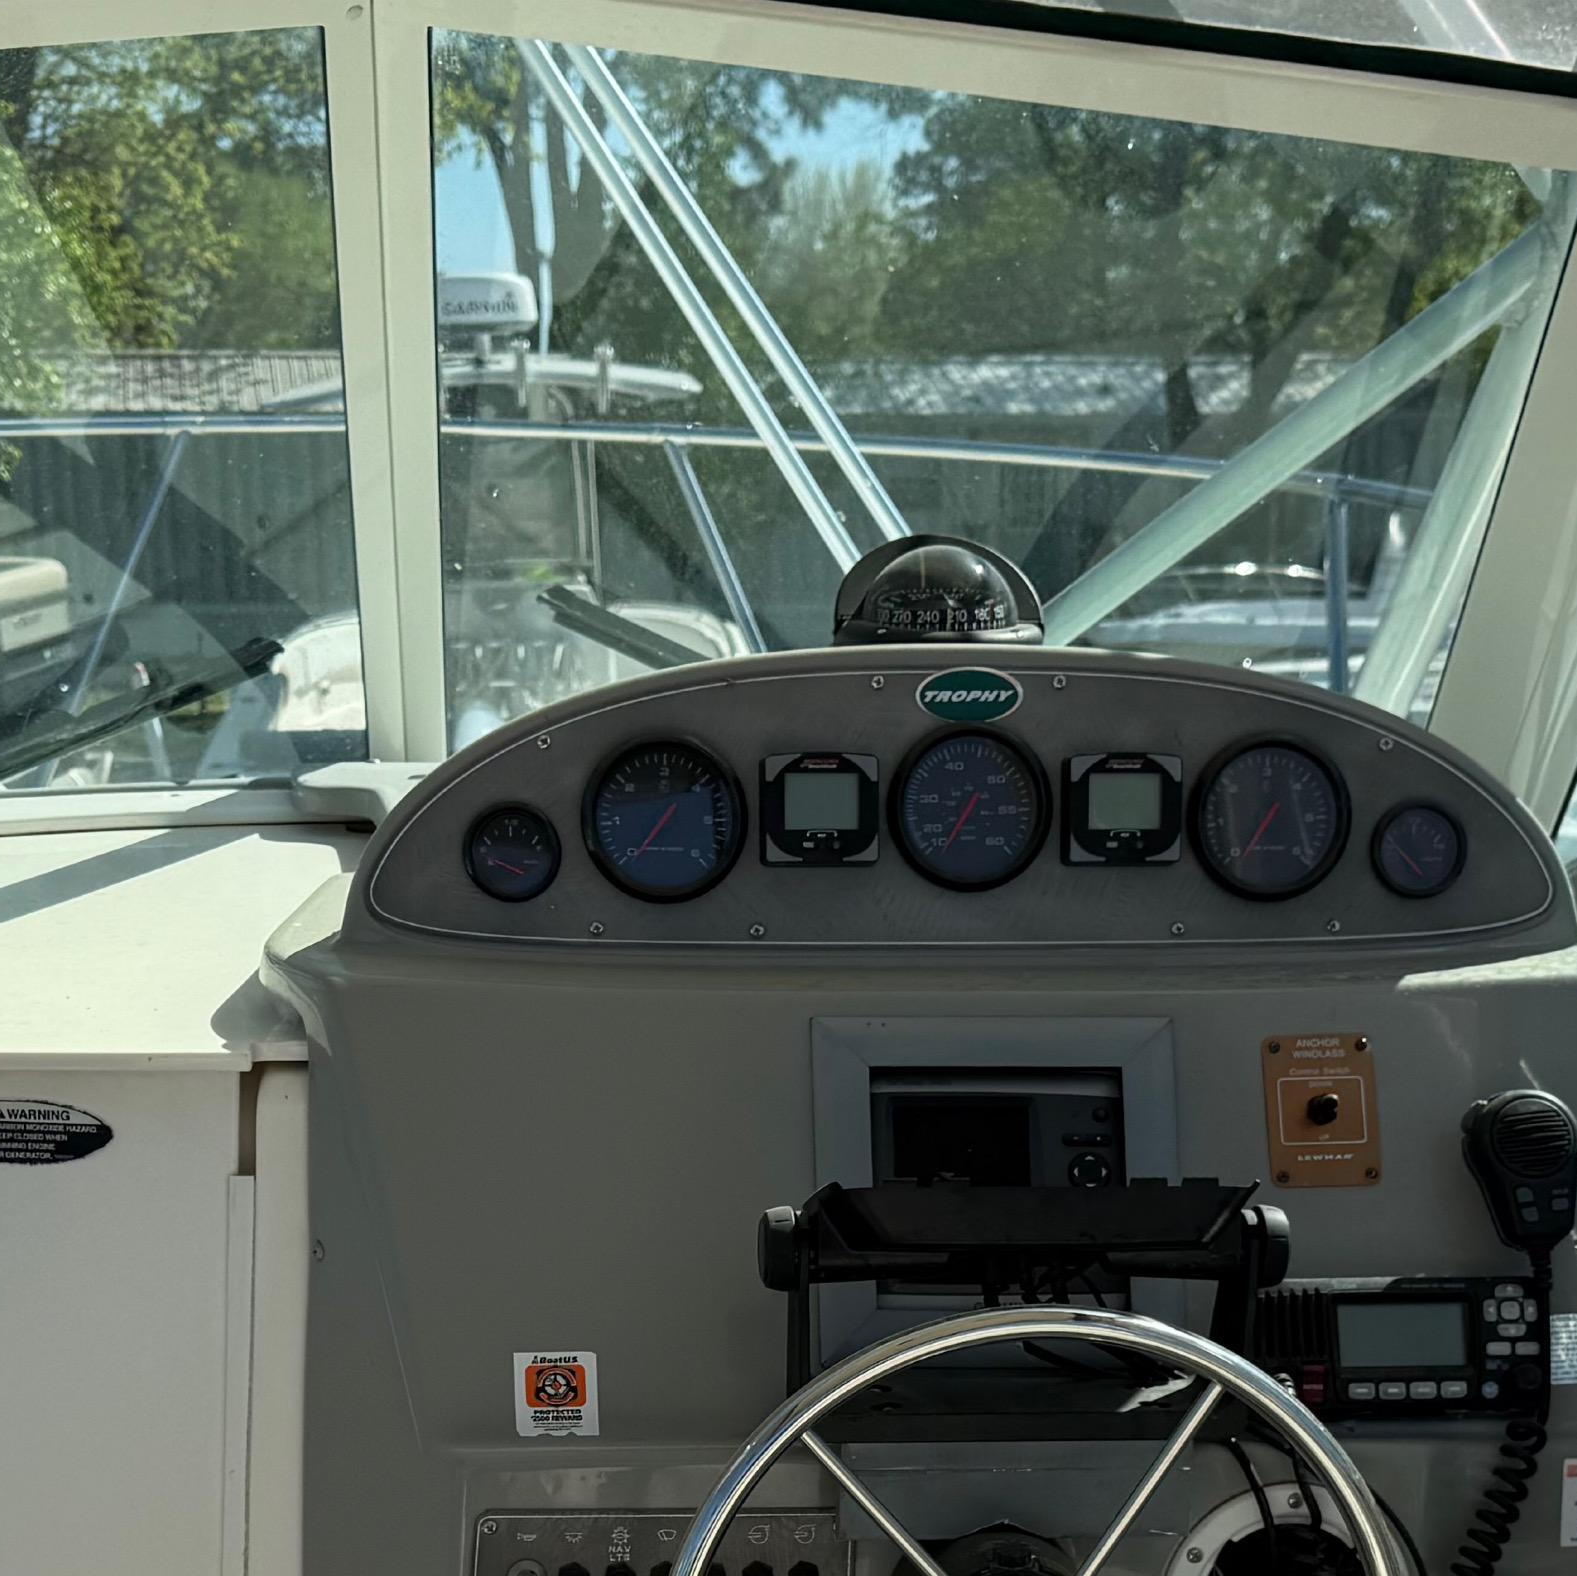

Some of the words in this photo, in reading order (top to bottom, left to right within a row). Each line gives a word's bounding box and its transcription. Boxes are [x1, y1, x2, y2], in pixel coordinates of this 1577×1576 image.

[917, 611, 939, 623] 240
[924, 690, 1014, 702] TROPHY
[944, 762, 964, 770] 40
[987, 775, 1006, 784] 50
[920, 794, 938, 803] 30
[923, 823, 942, 832] 20
[1296, 1038, 1340, 1047] ANCHOR
[1292, 1049, 1345, 1058] WINDLASS
[7, 1109, 70, 1121] WARNING
[66, 1125, 97, 1133] HAZARD
[14, 1132, 44, 1141] CLOSED
